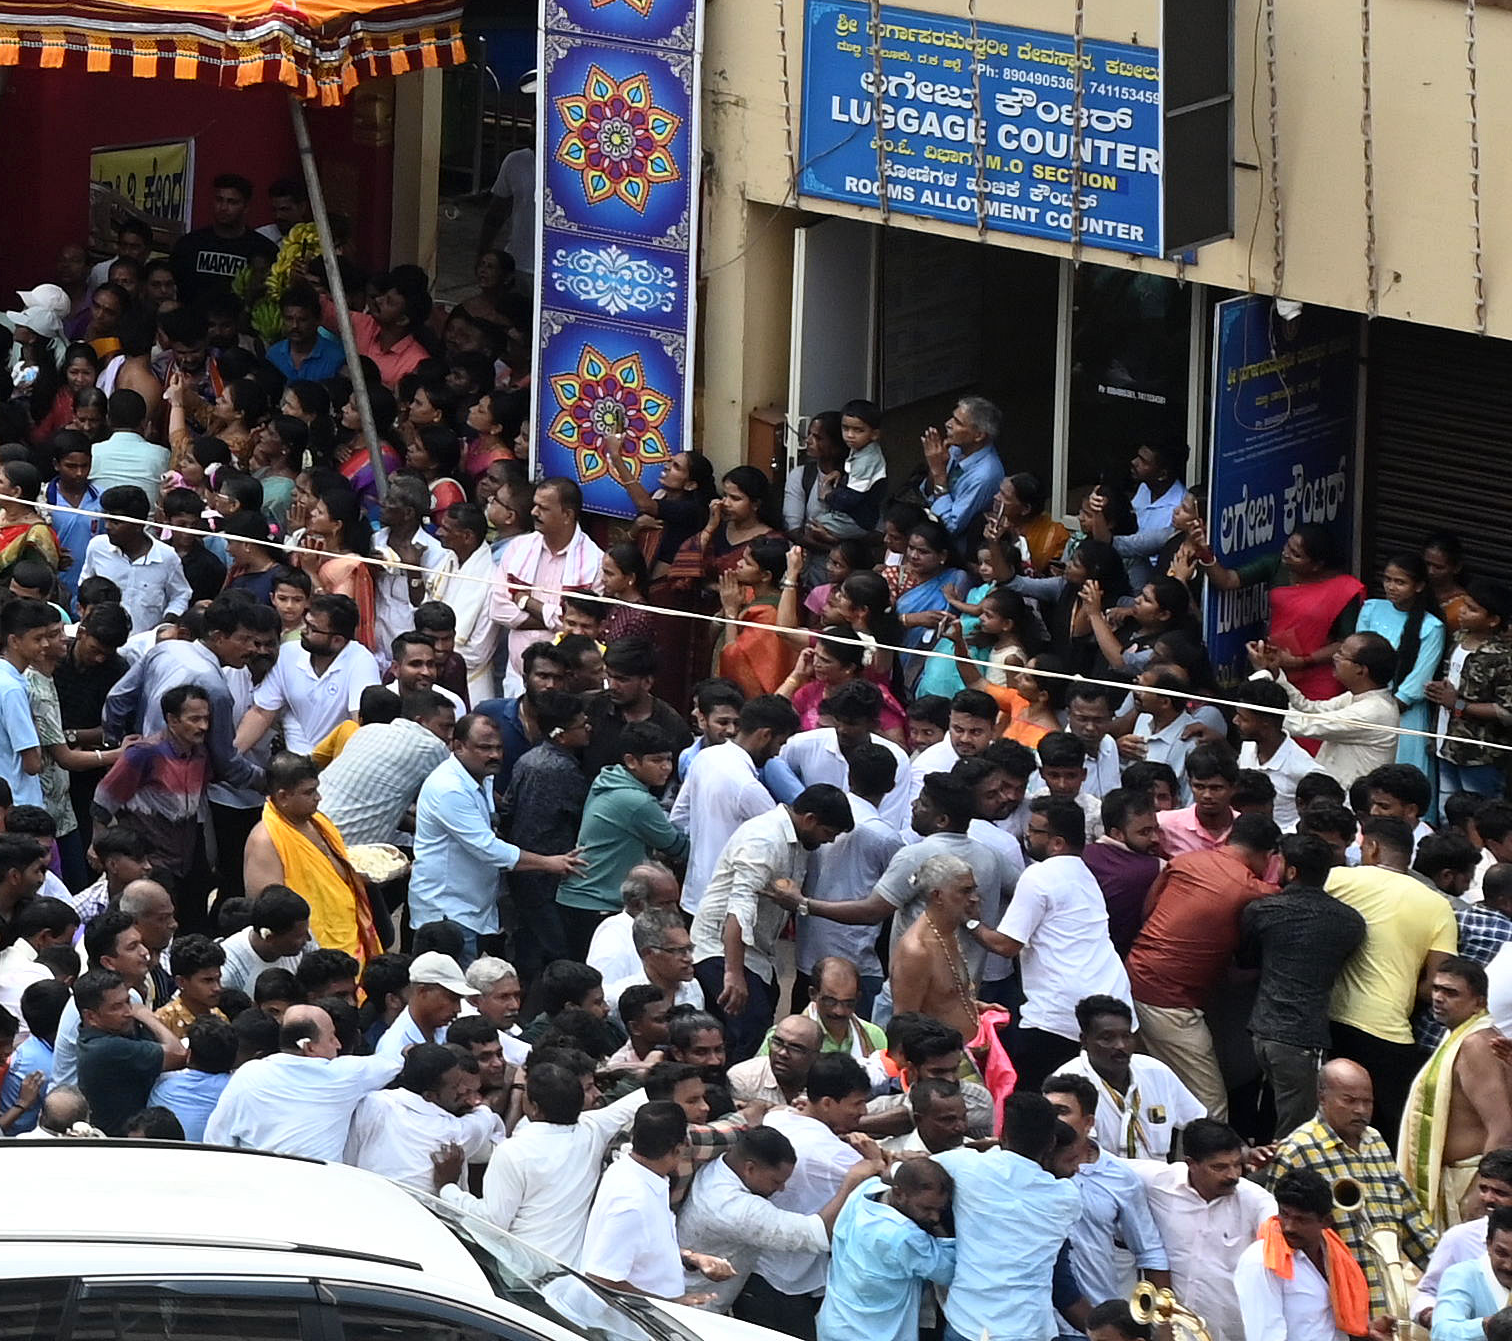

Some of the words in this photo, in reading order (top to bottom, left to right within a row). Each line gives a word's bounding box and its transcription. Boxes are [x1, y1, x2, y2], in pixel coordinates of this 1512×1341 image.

[860, 71, 975, 110] ಲಗೇಜು
[977, 63, 999, 79] Ph:
[1003, 67, 1086, 94] 890490536,
[831, 95, 987, 146] LUGGAGE
[997, 123, 1161, 175] COUNTER
[1032, 164, 1117, 191] SECTION
[845, 175, 915, 202] ROOMS
[920, 189, 1040, 223] ALLOTMENT
[1045, 210, 1144, 242] COUNTER
